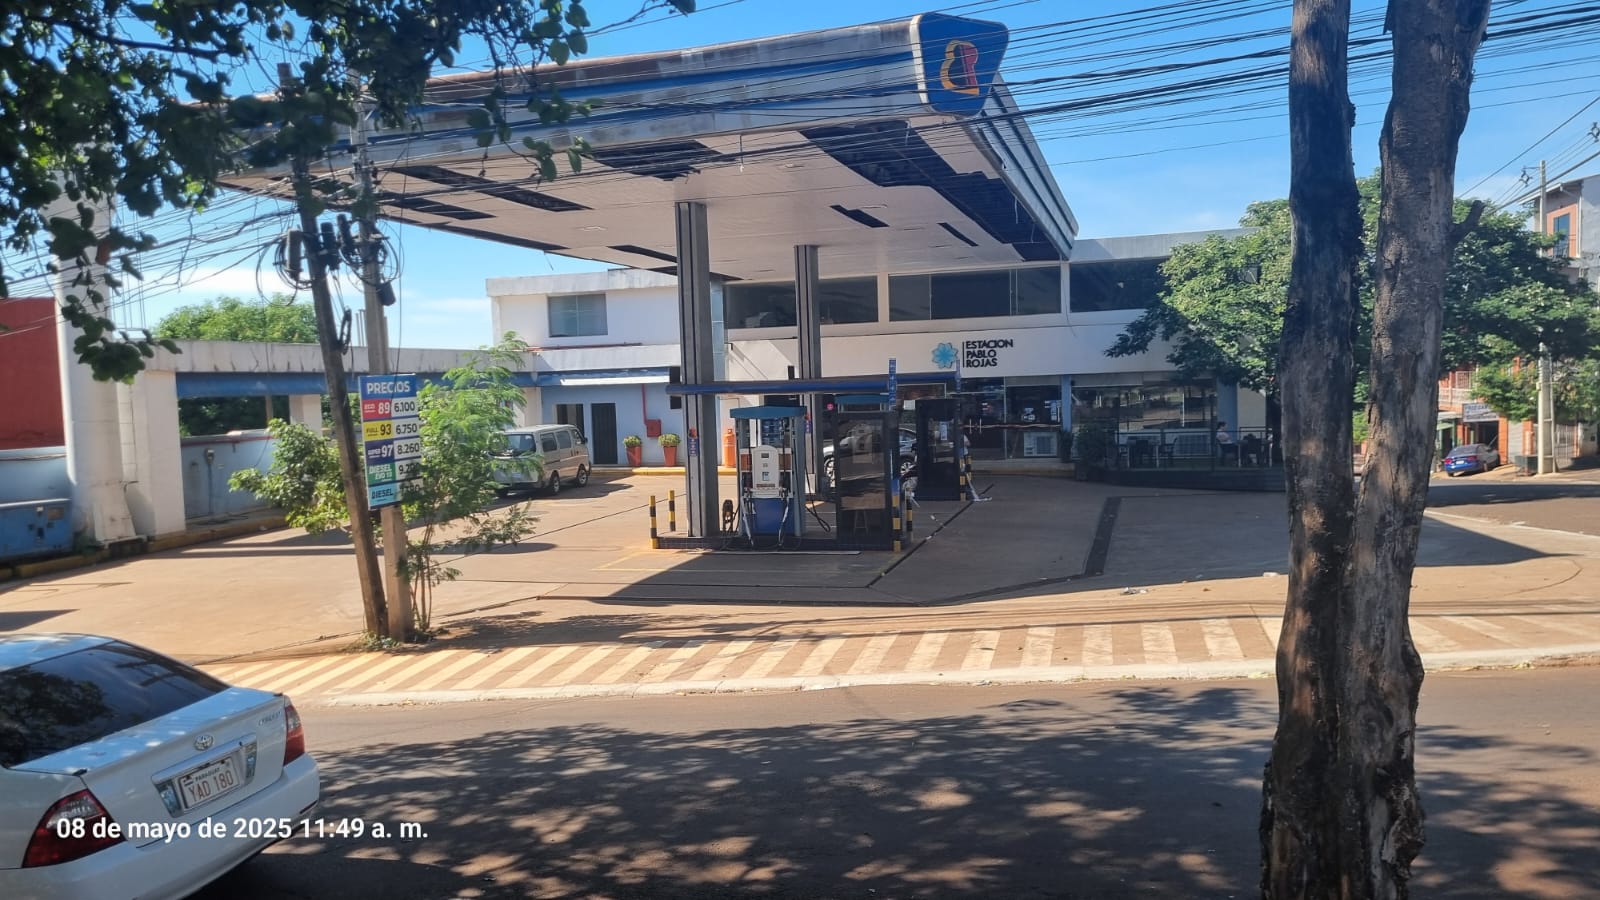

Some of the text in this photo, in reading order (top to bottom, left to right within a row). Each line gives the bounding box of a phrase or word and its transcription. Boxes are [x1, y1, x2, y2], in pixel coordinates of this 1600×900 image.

[965, 338, 1013, 349] ESTACION
[966, 349, 997, 359] PABLO
[965, 358, 998, 368] ROJAS
[366, 381, 411, 394] PRECIOS
[378, 402, 391, 415] 89
[394, 401, 416, 413] 6.100
[380, 423, 392, 436] 93
[395, 423, 418, 435] 6.750
[381, 444, 393, 458] 97
[397, 442, 420, 455] 8.260
[368, 464, 392, 475] DIESEL
[371, 488, 394, 499] DIESEL
[195, 768, 220, 781] PARAGUAY
[189, 770, 234, 801] YAD 180
